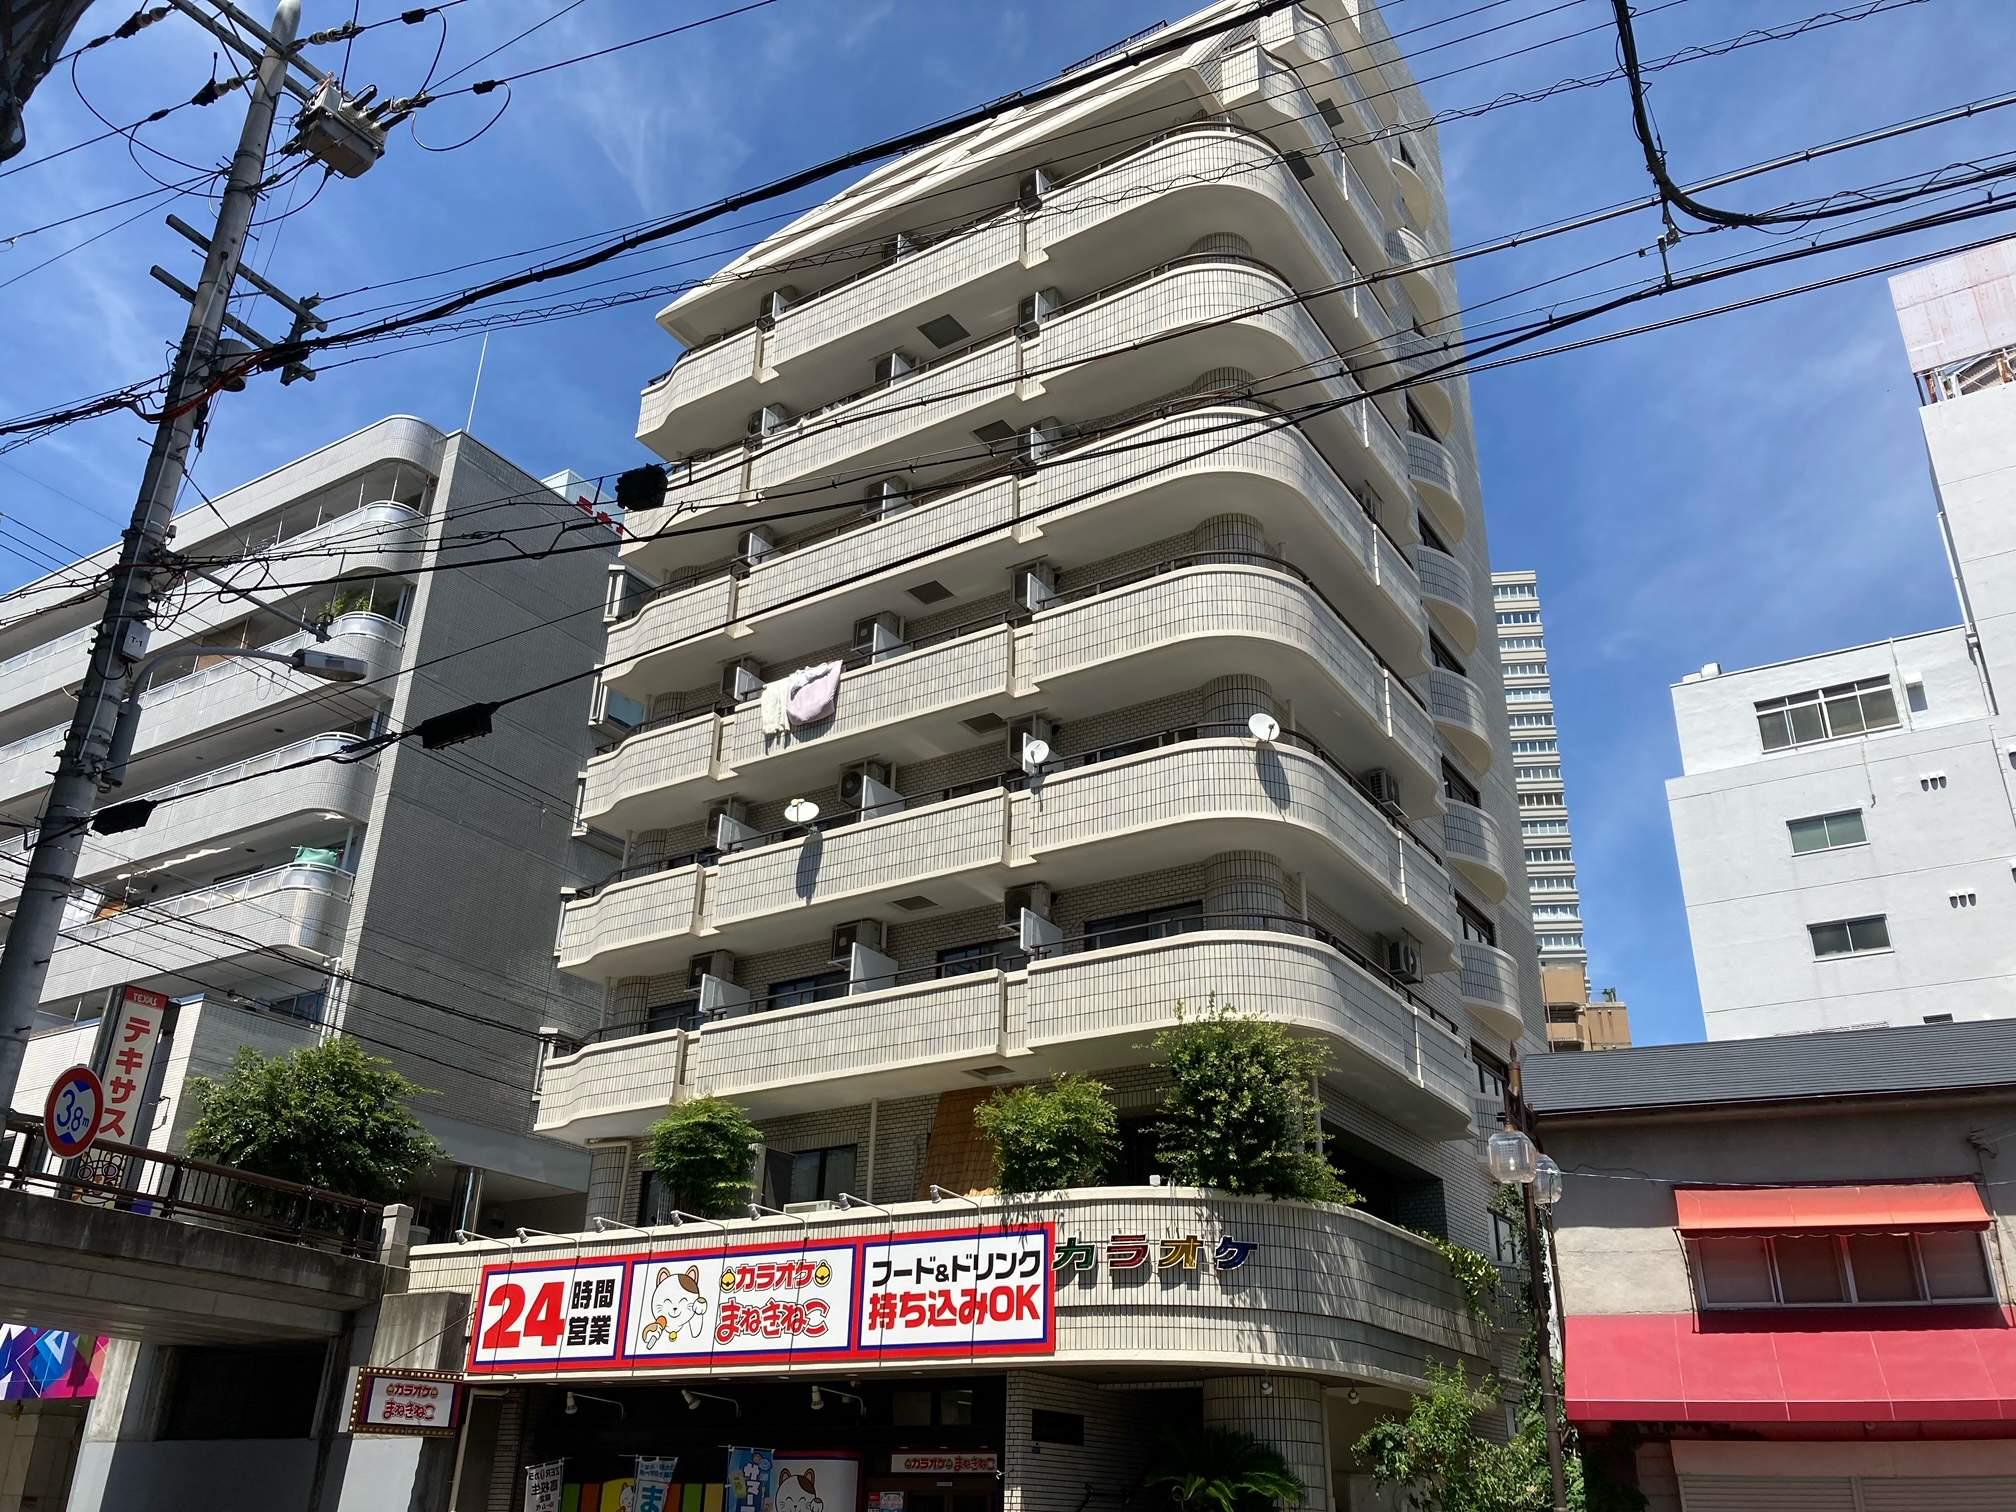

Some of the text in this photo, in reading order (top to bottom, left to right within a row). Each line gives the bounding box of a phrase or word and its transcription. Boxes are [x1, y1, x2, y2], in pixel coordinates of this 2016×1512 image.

[99, 1016, 150, 1138] テキサス
[871, 1250, 1041, 1287] フード&ドリンク
[1052, 1233, 1259, 1271] カラオケ
[734, 1261, 816, 1293] カラオケ
[482, 1278, 616, 1350] 24 時間
[714, 1297, 831, 1344] まねきねこ
[868, 1284, 1041, 1331] 持ち込みOK
[566, 1314, 612, 1347] 営業
[395, 1383, 432, 1397] カラオケ
[383, 1399, 435, 1421] まねきねこ
[911, 1457, 945, 1470] カラオケ
